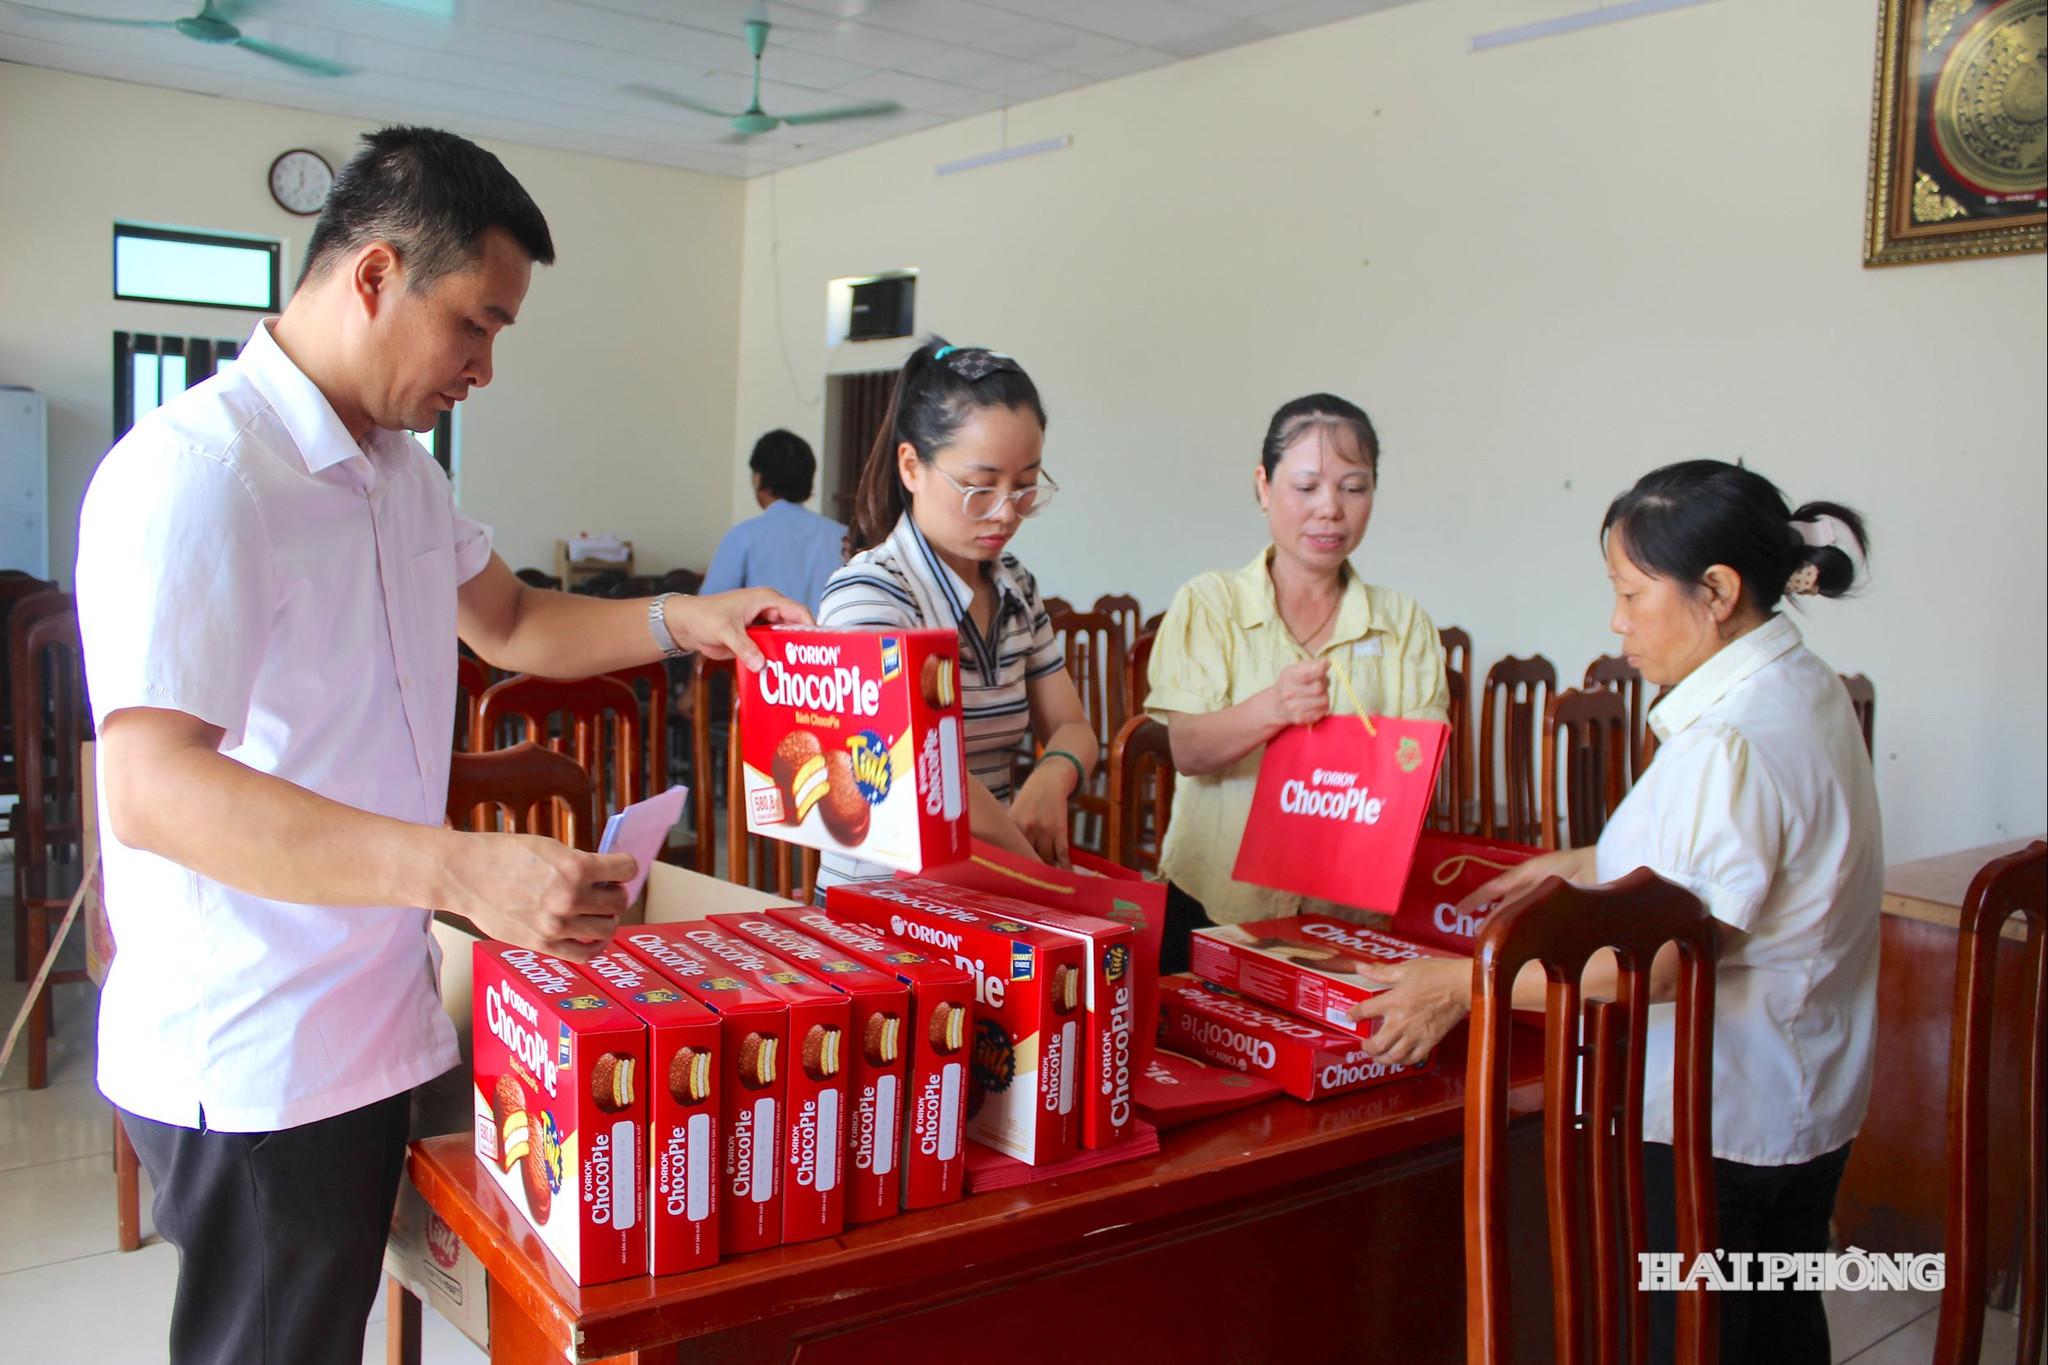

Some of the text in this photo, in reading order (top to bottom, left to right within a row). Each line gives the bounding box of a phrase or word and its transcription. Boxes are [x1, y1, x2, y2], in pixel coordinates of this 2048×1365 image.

[798, 644, 838, 666] ORION
[759, 659, 880, 717] ChocoPie
[1280, 779, 1381, 825] ChocoPie
[628, 934, 706, 977] ChocoPie
[685, 930, 766, 971] ChocoPie
[738, 921, 821, 960] ChocoPie
[799, 915, 885, 952] ChocoPie
[907, 921, 959, 952] ORION
[500, 949, 571, 994] ChocoPie
[511, 989, 538, 1027] ORION
[486, 985, 556, 1099] ChocoPie
[1103, 1031, 1112, 1079] ORION
[1111, 986, 1130, 1127] ChocoPie
[1181, 1014, 1277, 1070] ChocoPie
[1045, 1033, 1061, 1111] ChocoPie
[856, 1086, 875, 1169] ChocoPie
[917, 1097, 925, 1125] ORION
[921, 1074, 941, 1155] ChocoPie
[727, 1136, 735, 1165] ORION
[733, 1110, 752, 1197] ChocoPie
[791, 1126, 800, 1155] ORION
[797, 1101, 816, 1186] ChocoPie
[584, 1161, 592, 1191] ORION
[591, 1134, 610, 1225] ChocoPie
[660, 1153, 668, 1184] ORION
[667, 1126, 686, 1216] ChocoPie
